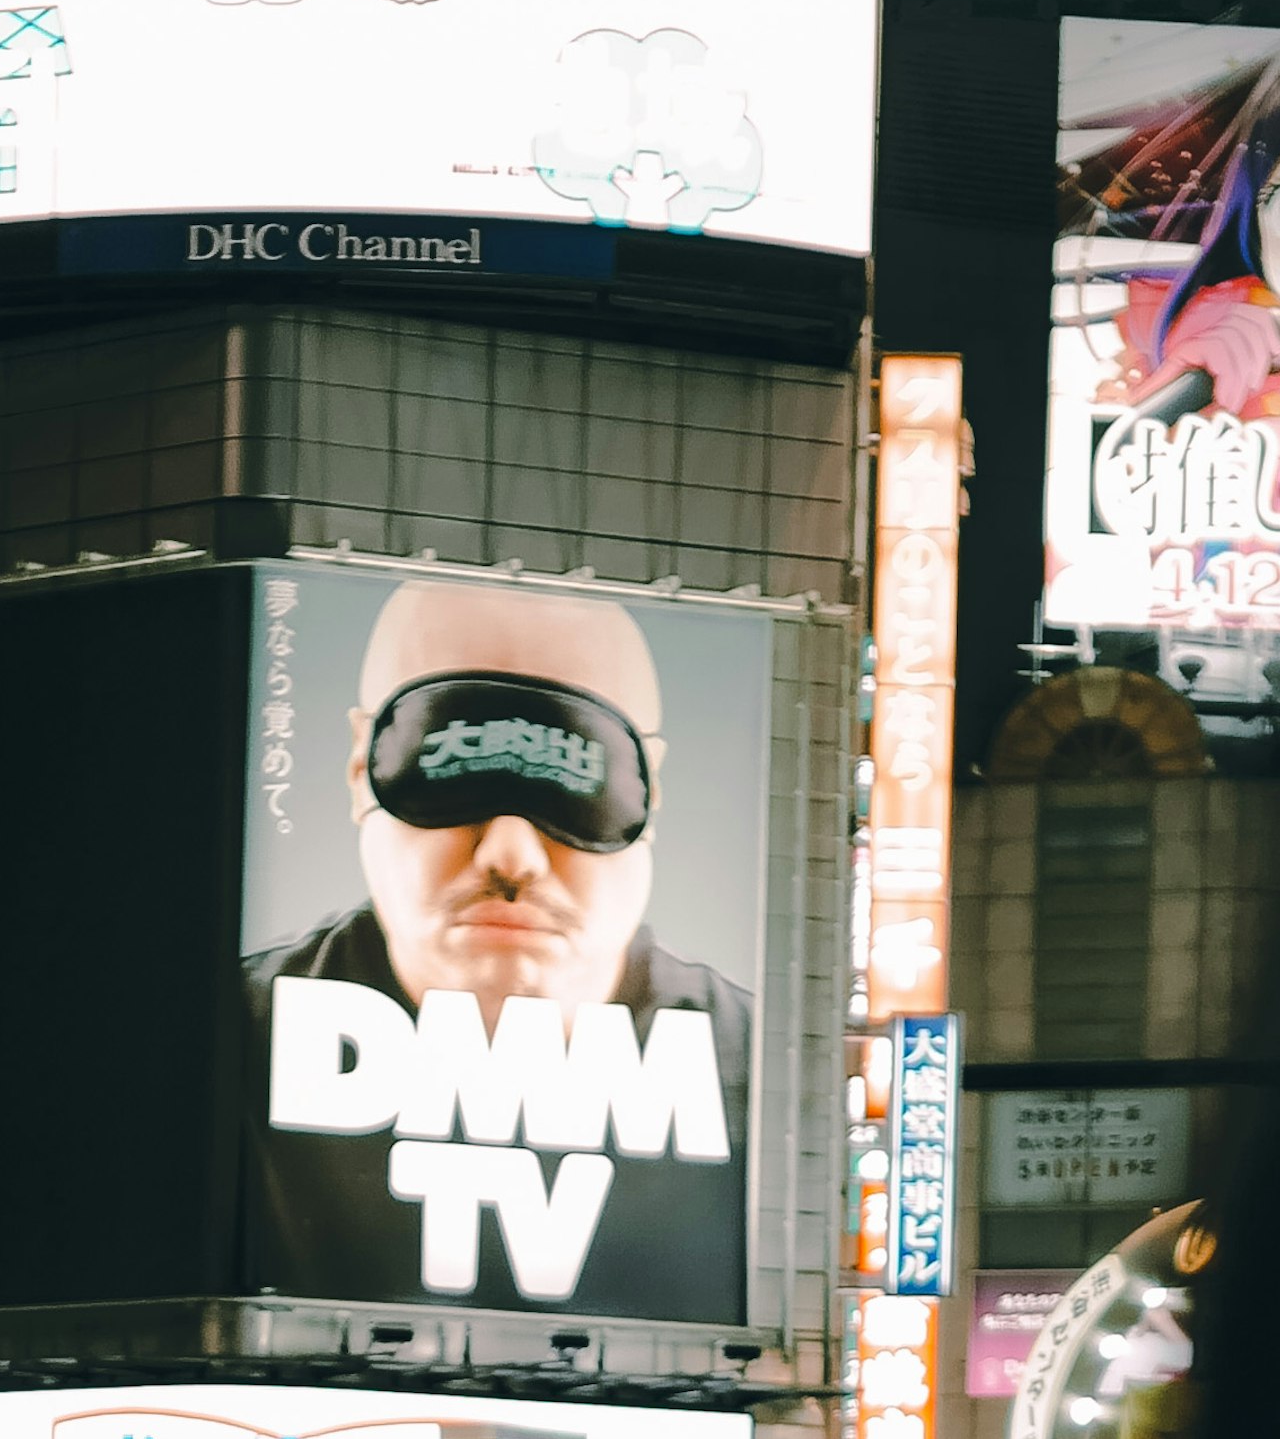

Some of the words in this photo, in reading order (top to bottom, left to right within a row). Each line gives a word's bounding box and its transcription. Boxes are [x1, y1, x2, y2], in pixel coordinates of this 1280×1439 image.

[185, 222, 289, 261] DHC
[299, 222, 481, 264] Channel
[269, 974, 730, 1162] DMM
[388, 1139, 614, 1301] TV
